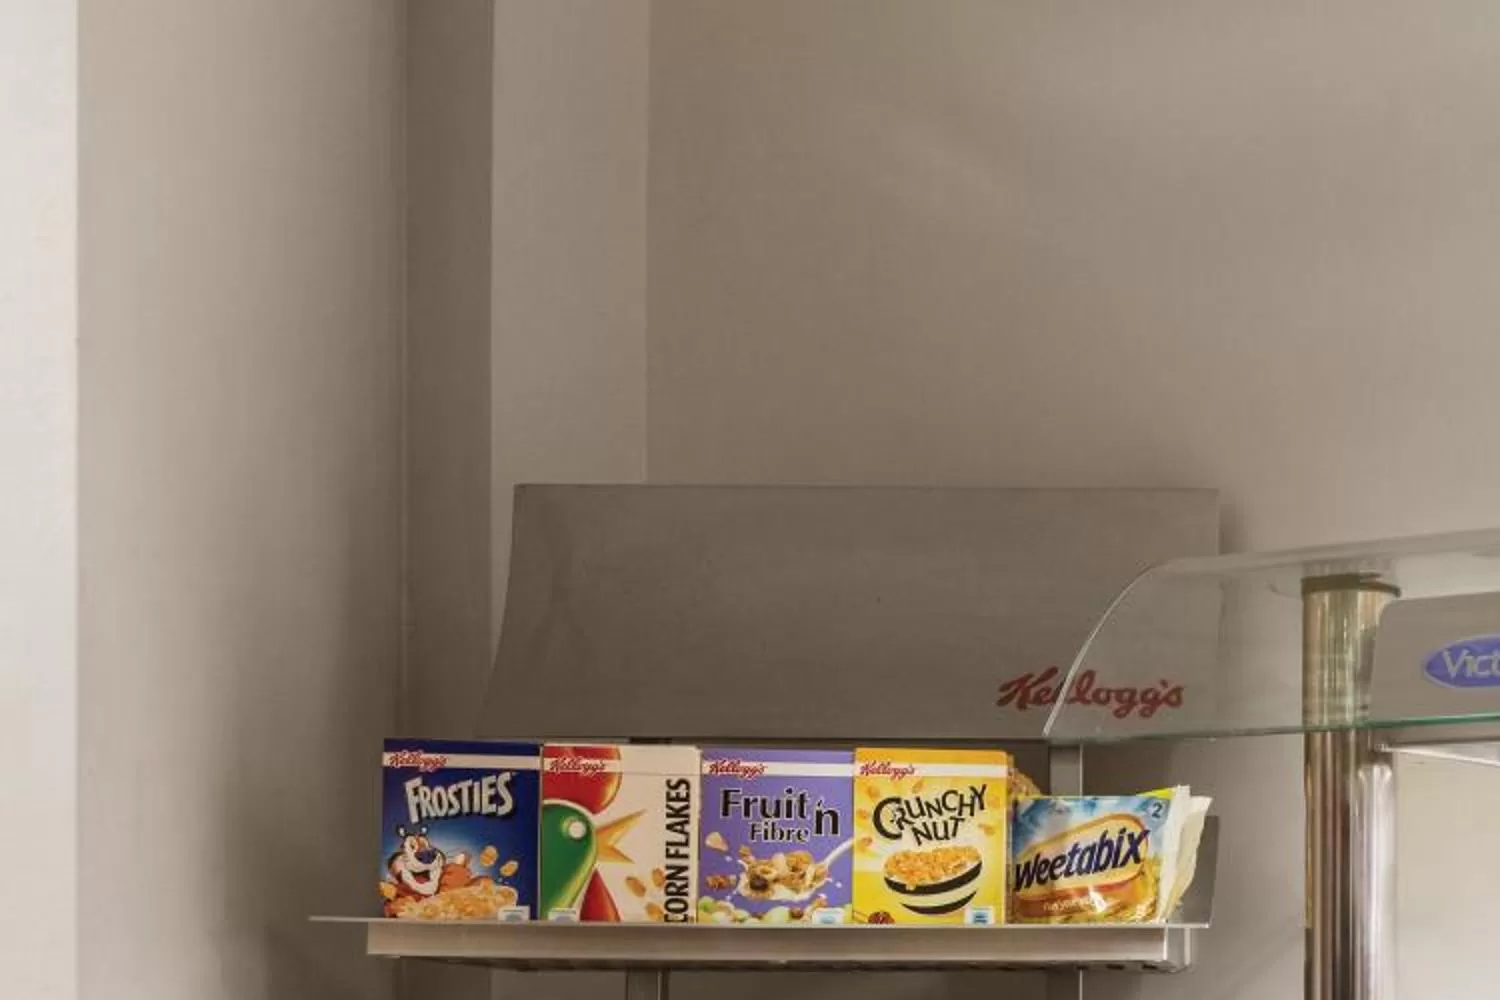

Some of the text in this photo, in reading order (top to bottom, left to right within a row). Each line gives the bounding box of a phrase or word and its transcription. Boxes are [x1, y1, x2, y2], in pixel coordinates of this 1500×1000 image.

[389, 749, 448, 772] Kellogg's
[550, 756, 606, 776] Kellogg's
[709, 760, 765, 780] Kellogg's
[860, 761, 915, 780] Kellogg's
[405, 772, 515, 823] FROSTIES
[720, 787, 808, 819] Fruit
[1152, 802, 1162, 818] 2
[873, 784, 987, 840] CRUNCHY
[749, 821, 809, 843] Fibre
[911, 816, 965, 846] NUT
[664, 777, 692, 923] CORN FLAKES
[1013, 828, 1151, 892] Weetabix
